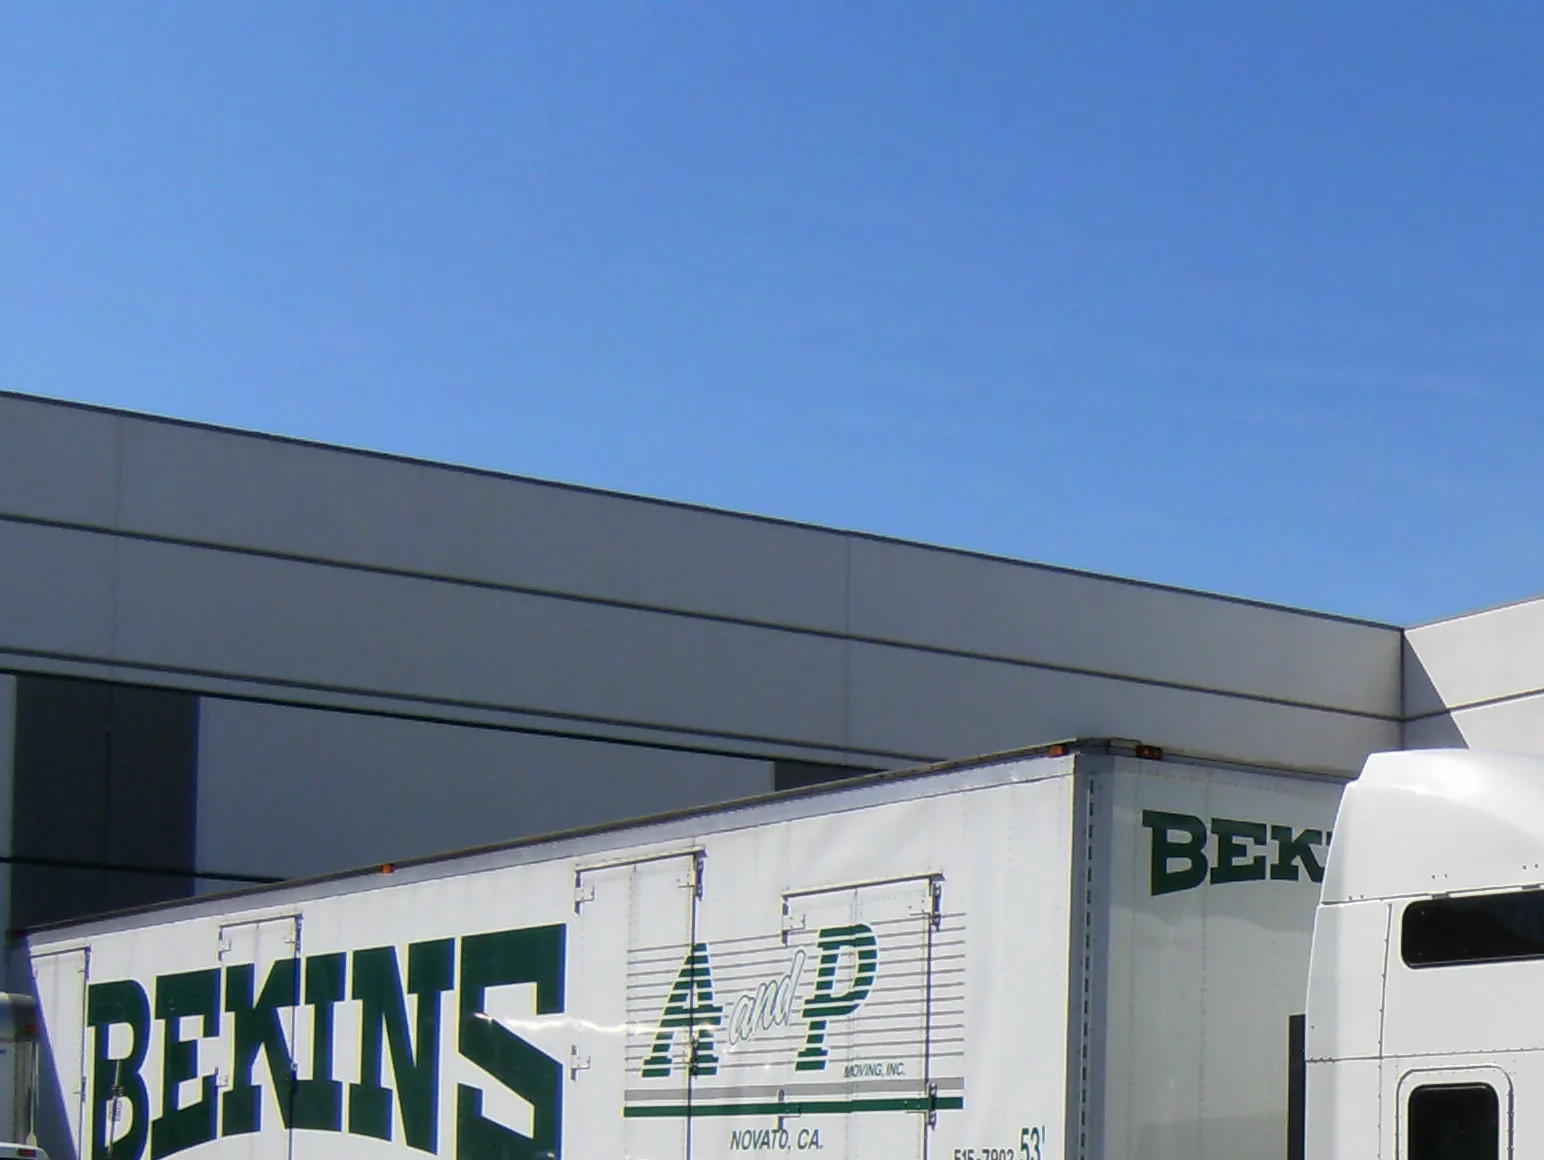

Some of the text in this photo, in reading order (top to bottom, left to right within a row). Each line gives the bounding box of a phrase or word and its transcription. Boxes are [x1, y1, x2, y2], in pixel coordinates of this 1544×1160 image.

[1142, 809, 1333, 896] BEK
[641, 922, 879, 1078] A and P
[886, 1062, 907, 1077] INC.
[730, 1128, 824, 1151] NOVATO, CA.
